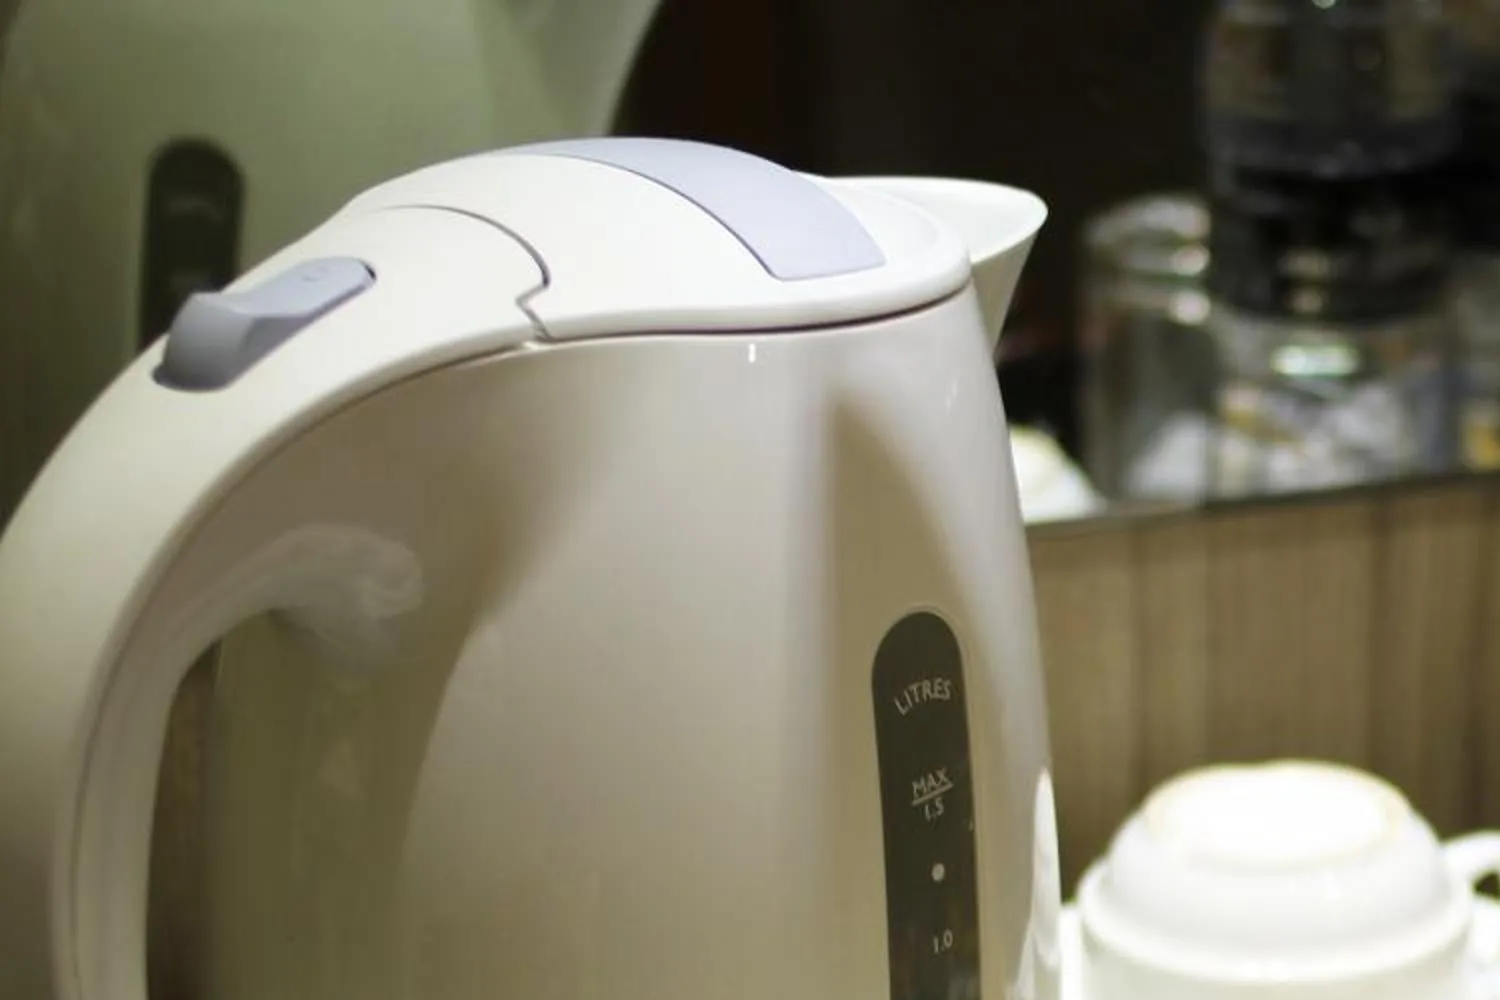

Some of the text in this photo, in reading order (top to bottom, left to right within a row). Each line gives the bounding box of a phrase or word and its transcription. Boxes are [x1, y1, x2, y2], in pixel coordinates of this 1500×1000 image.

[893, 677, 951, 717] LITRES
[911, 767, 951, 798] MAX
[932, 928, 954, 955] 1.0
